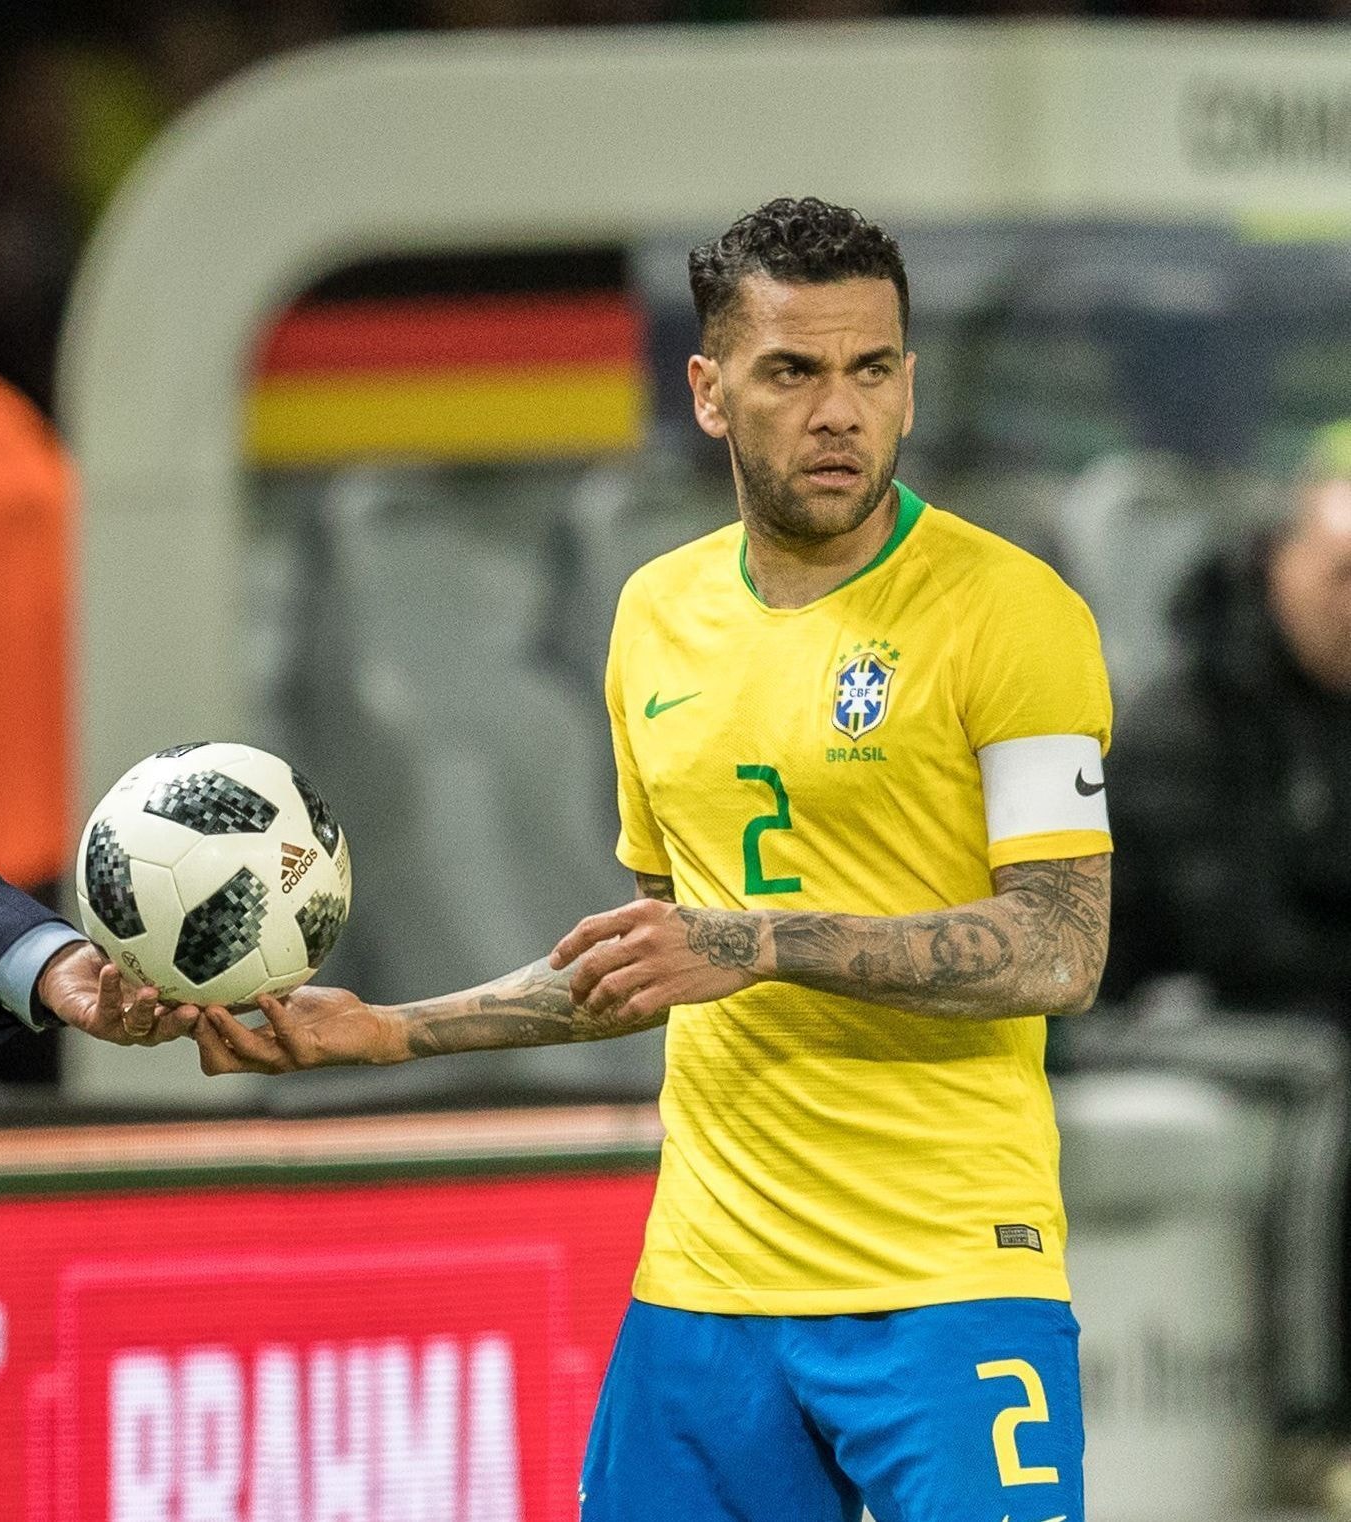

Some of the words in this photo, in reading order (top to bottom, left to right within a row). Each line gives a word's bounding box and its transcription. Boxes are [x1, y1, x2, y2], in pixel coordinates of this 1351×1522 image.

[849, 687, 871, 698] CBF
[825, 746, 887, 763] BRASIL
[736, 764, 802, 896] 2
[281, 848, 318, 894] adidas
[975, 1358, 1060, 1487] 2
